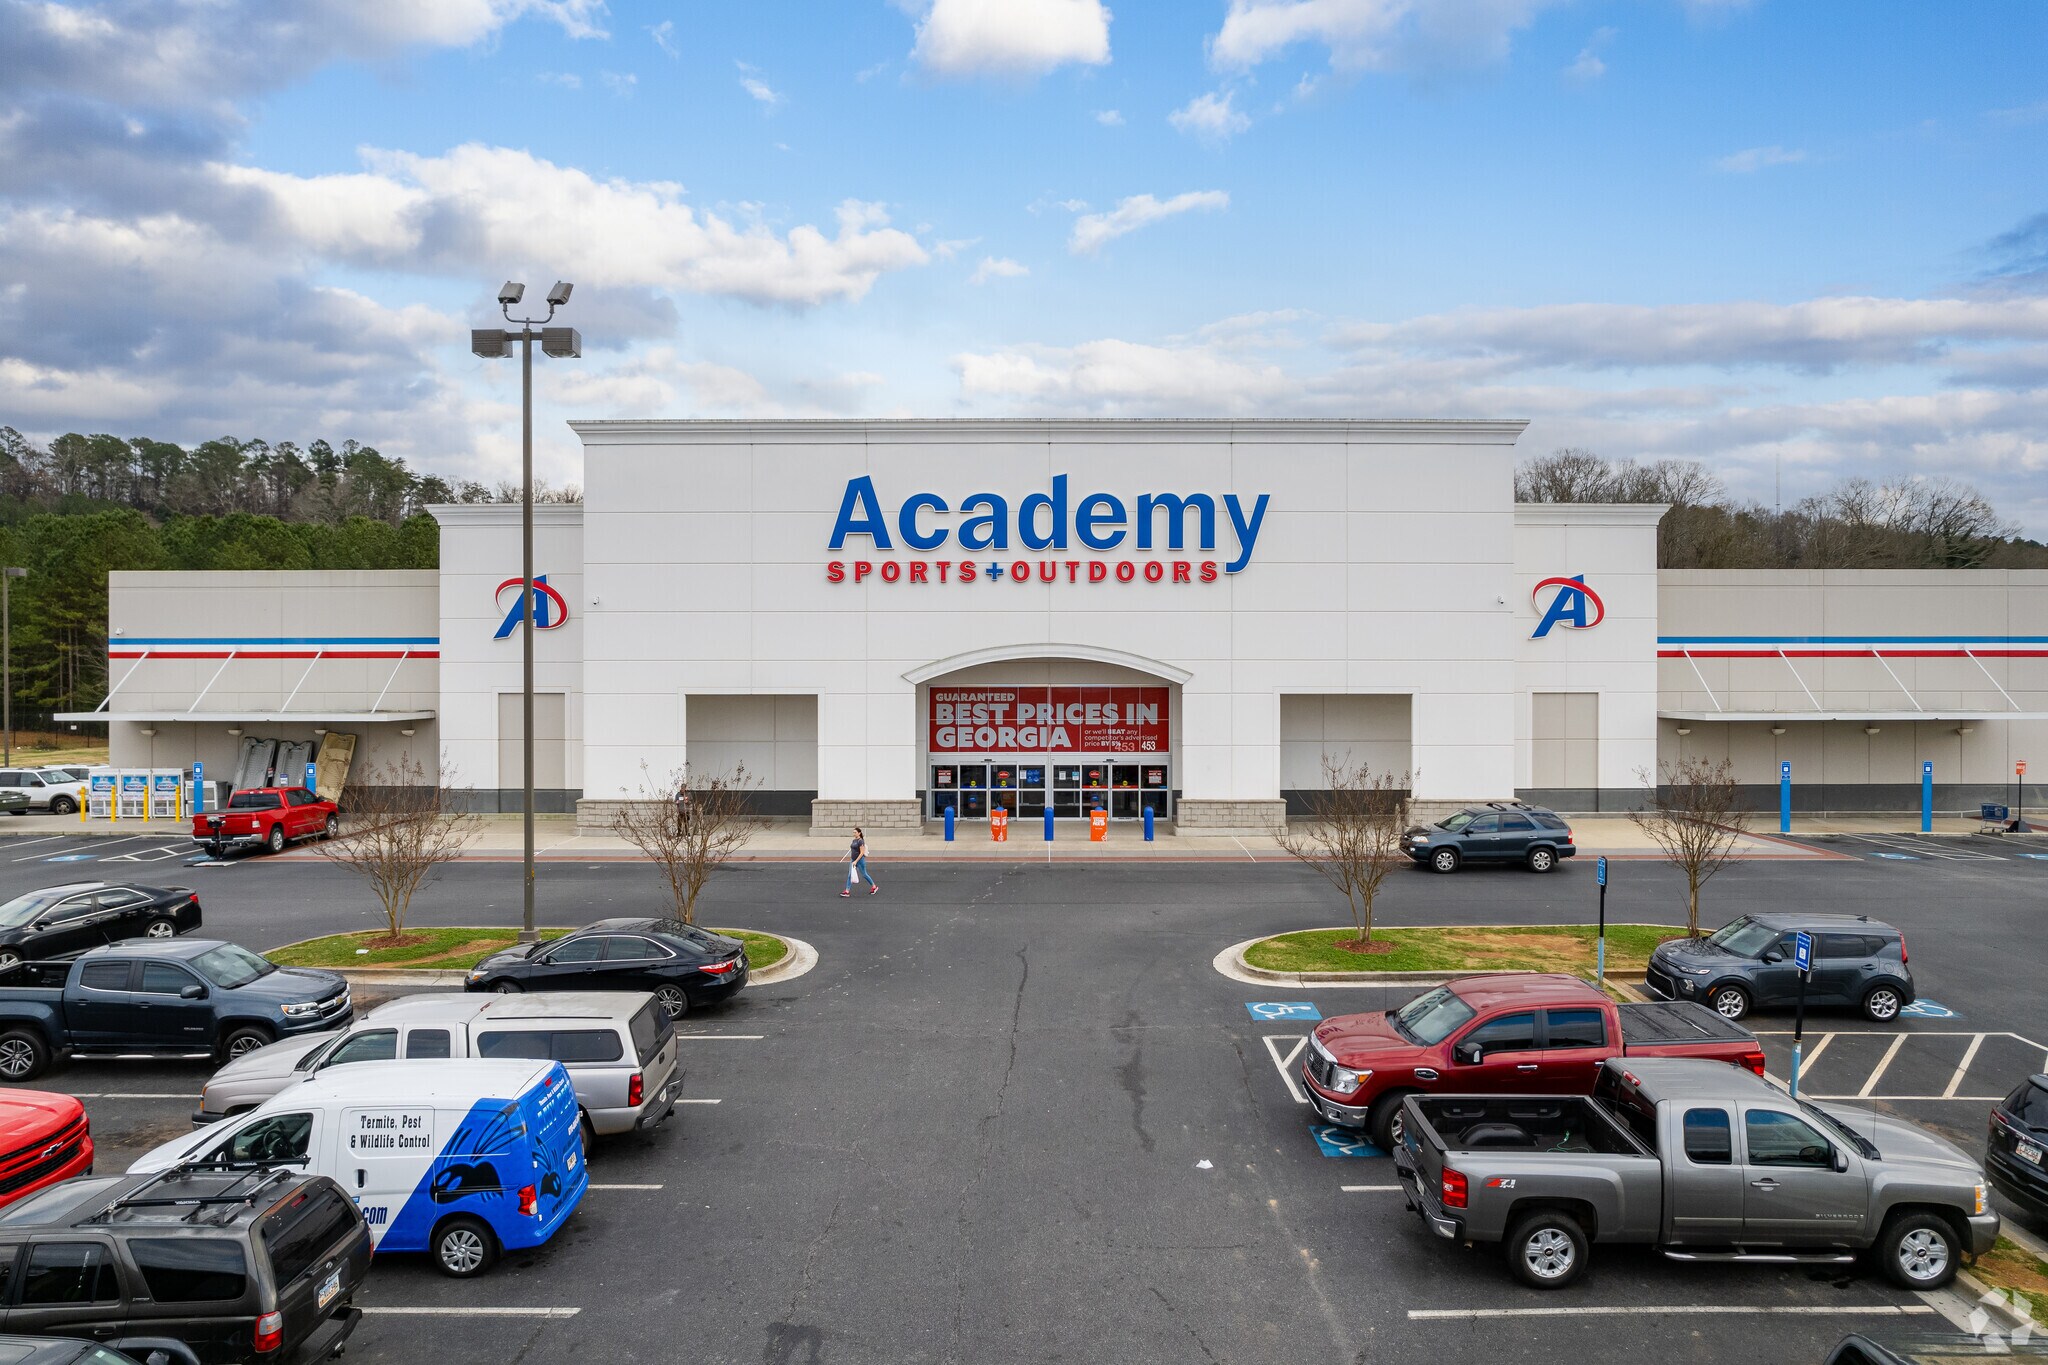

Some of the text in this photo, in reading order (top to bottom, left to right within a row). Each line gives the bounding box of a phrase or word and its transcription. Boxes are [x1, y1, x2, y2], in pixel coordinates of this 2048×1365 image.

[826, 473, 1271, 575] Academy
[935, 692, 1016, 702] GUARANTEED
[936, 703, 1158, 725] BEST PRICES IN
[935, 726, 1072, 748] GEORGIA
[1114, 742, 1135, 752] 453
[1141, 741, 1156, 751] 453
[360, 1115, 422, 1130] Termite, Pest
[350, 1134, 430, 1148] & Wildlife Control
